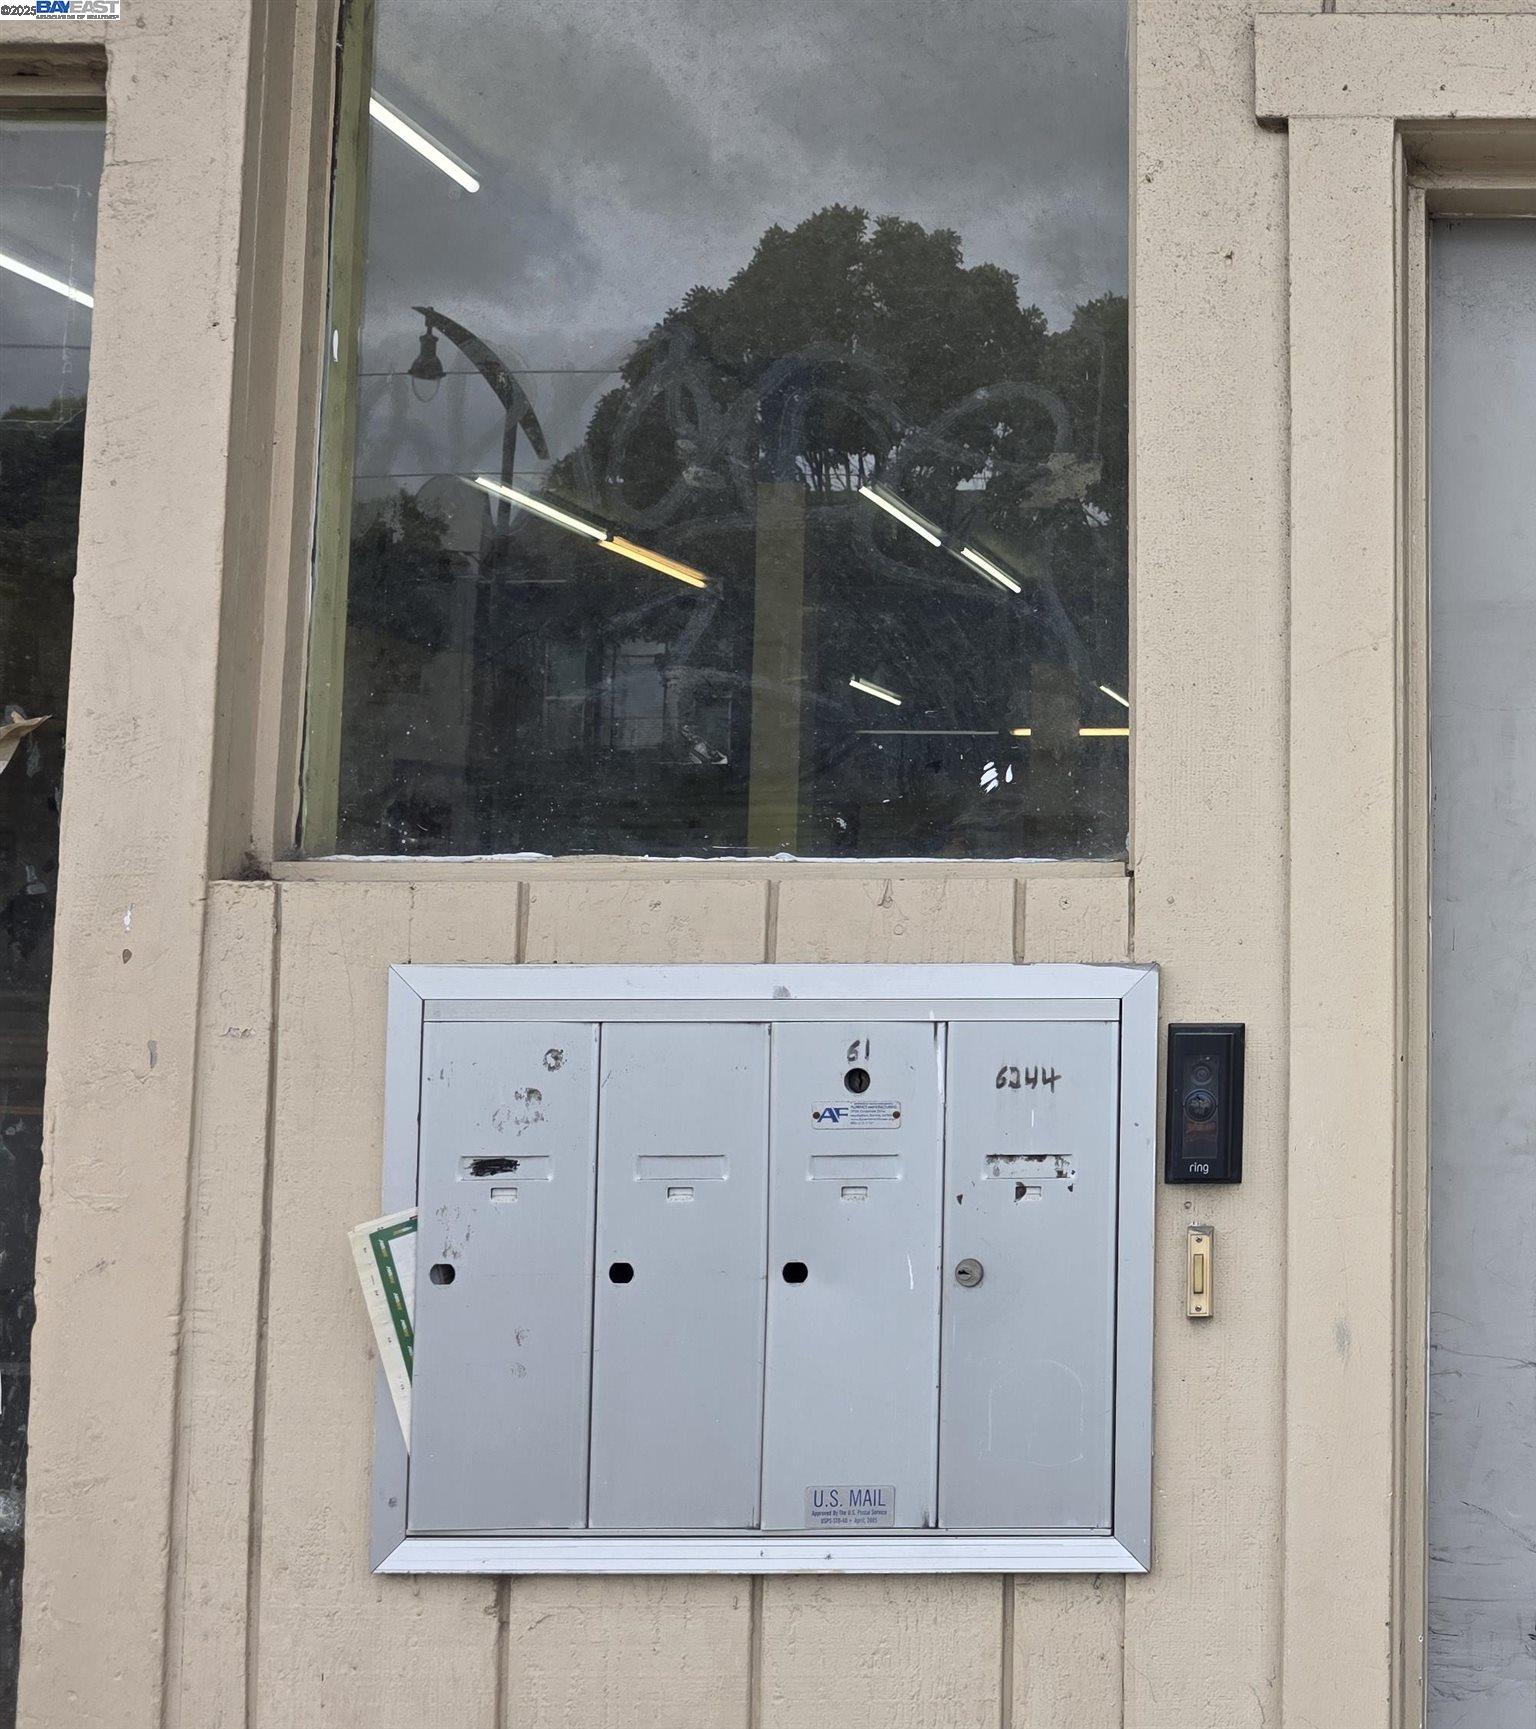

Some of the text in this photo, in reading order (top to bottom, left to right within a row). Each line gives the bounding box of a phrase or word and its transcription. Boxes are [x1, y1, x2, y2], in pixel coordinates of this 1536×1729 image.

[995, 1065, 1062, 1094] 6244
[1189, 1162, 1209, 1175] ring
[813, 1489, 886, 1508] U.S. MAIL
